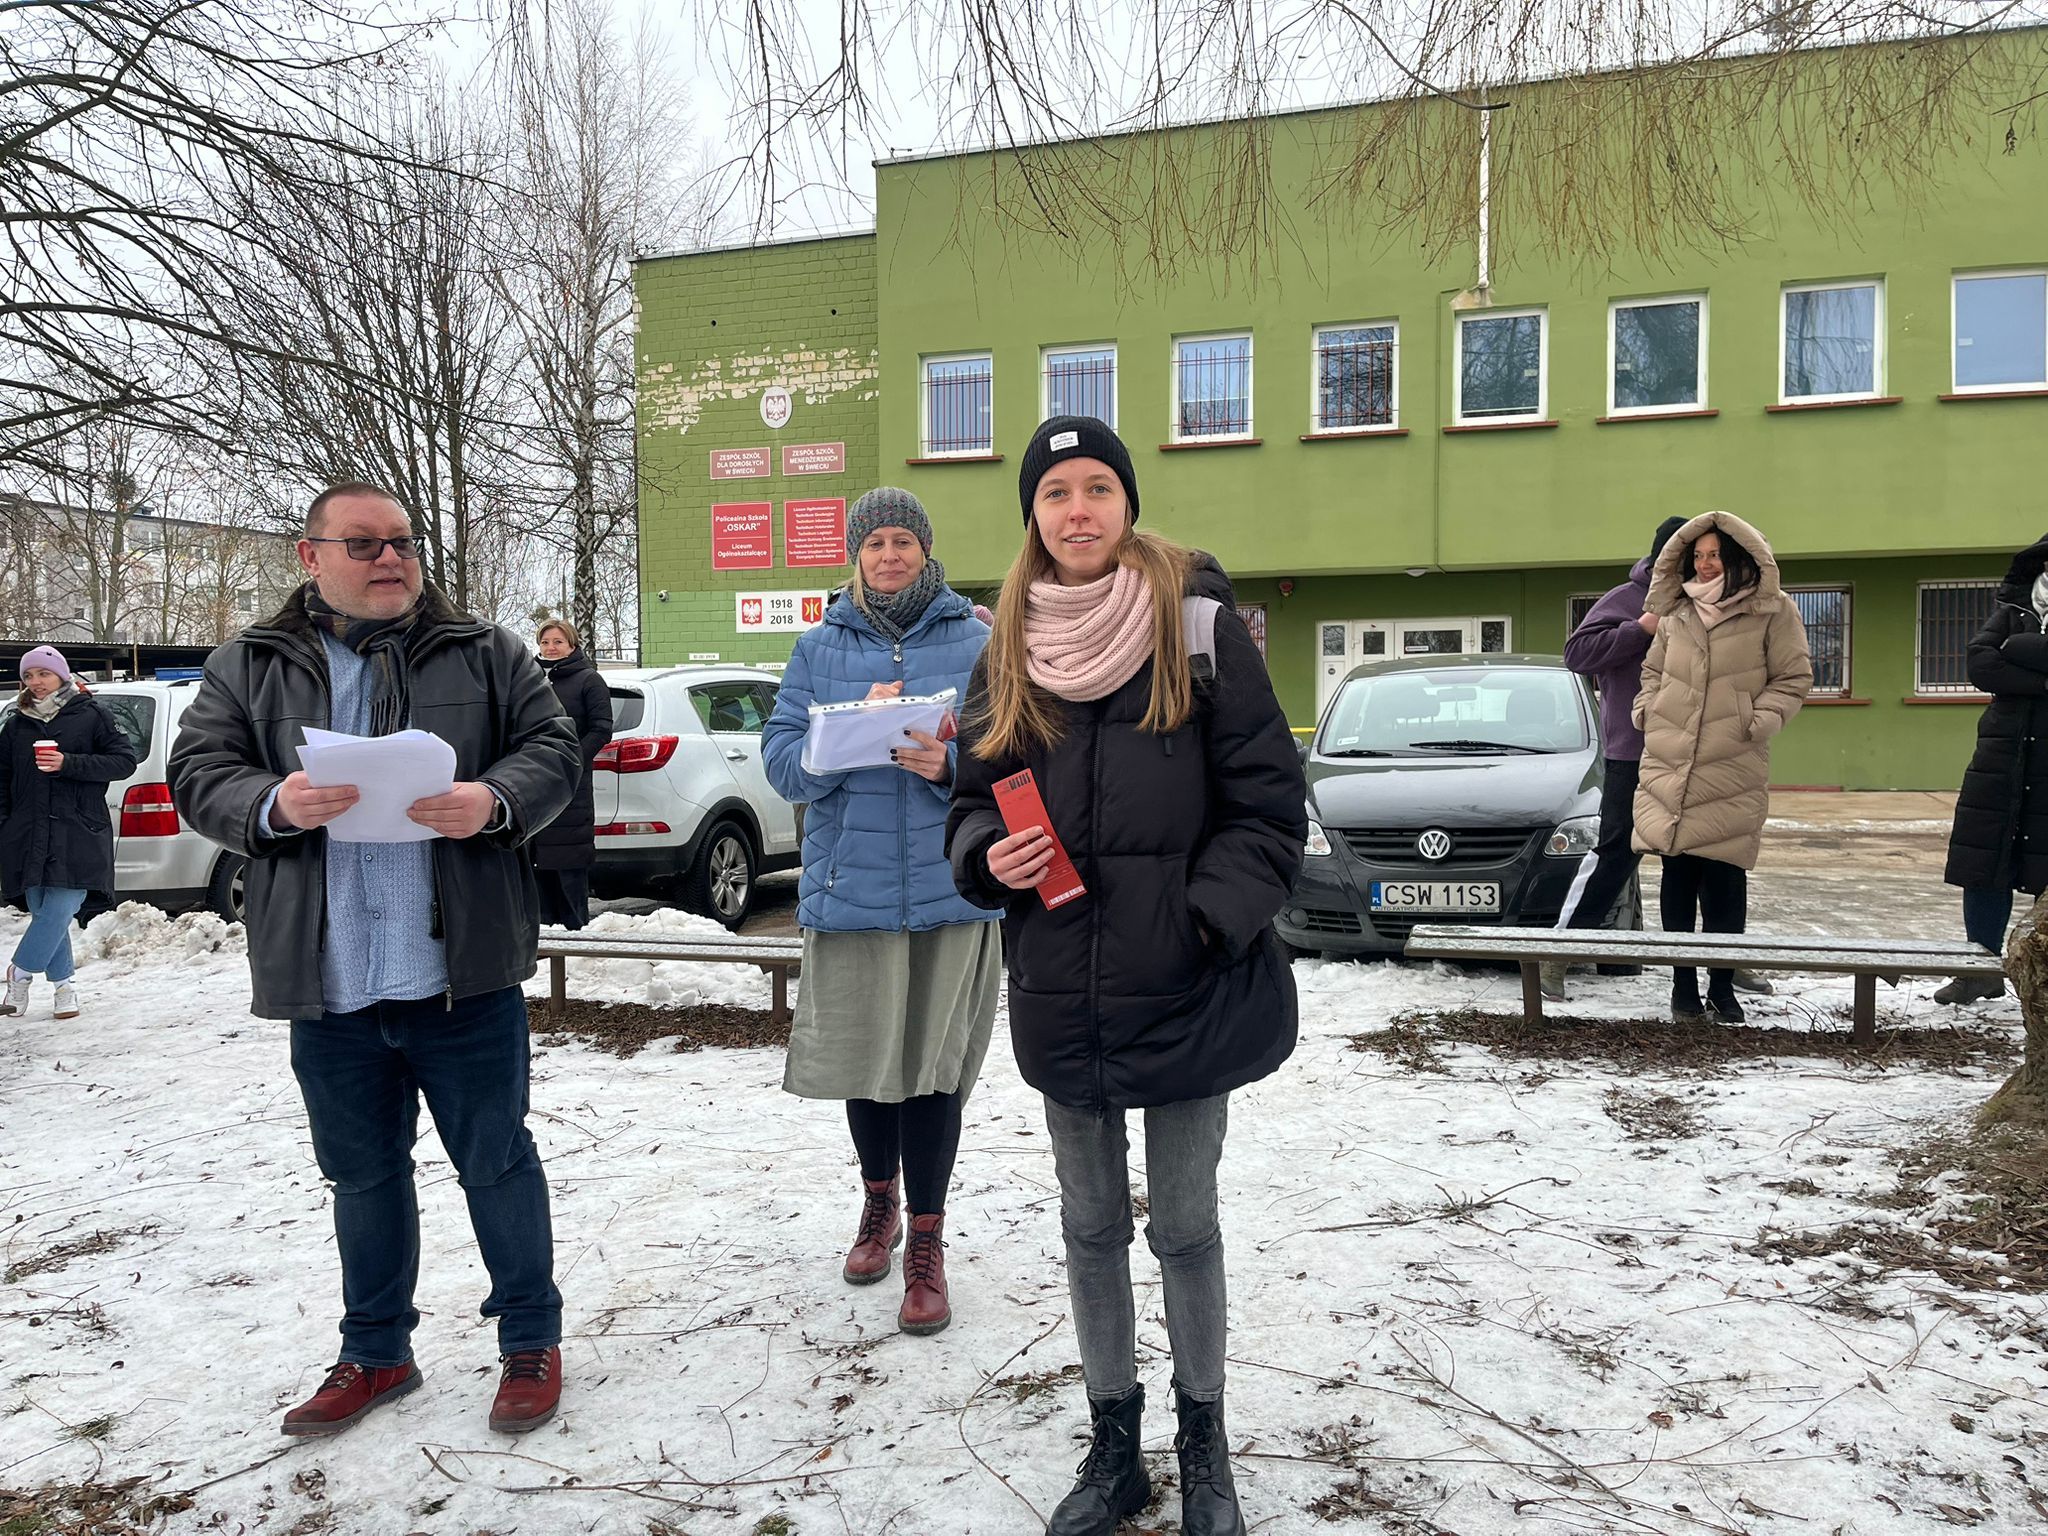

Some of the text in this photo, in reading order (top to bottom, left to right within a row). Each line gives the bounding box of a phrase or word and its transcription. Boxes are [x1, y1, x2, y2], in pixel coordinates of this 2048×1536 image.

[719, 453, 741, 461] ZESPÓŁ
[792, 447, 835, 457] ZESPÓŁ SZKÓŁ
[729, 460, 764, 468] DOROSŁYCH
[770, 598, 793, 609] 1918
[770, 614, 794, 625] 2018
[1384, 885, 1496, 906] CSW 11S3
